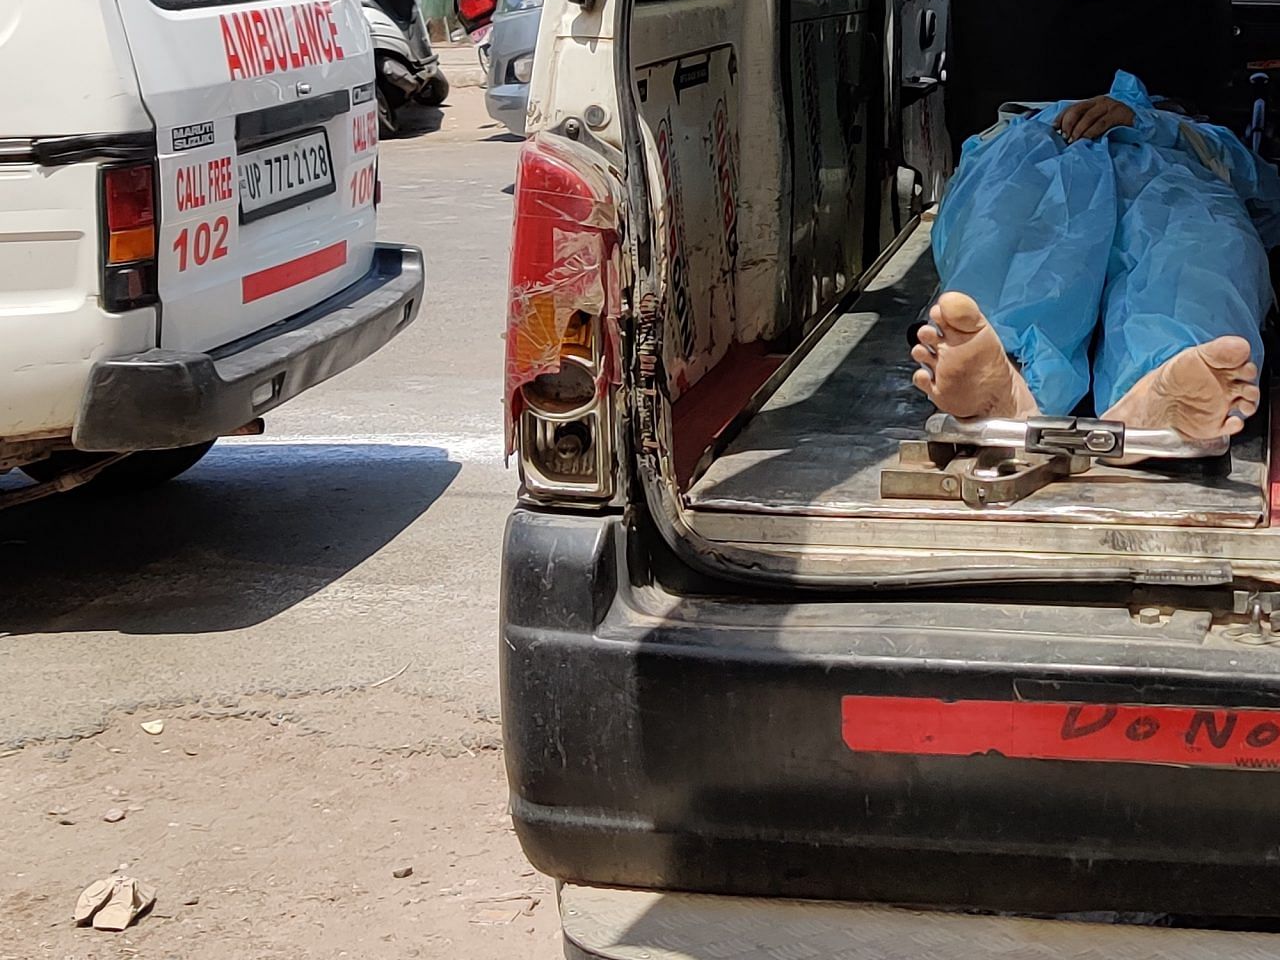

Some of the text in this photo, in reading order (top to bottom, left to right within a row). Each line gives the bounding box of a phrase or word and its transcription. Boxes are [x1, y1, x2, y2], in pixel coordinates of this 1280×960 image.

[219, 1, 343, 81] AMBULANCE
[173, 123, 213, 139] MARUTI
[174, 134, 214, 150] SUZUKI
[176, 163, 205, 212] CALL
[208, 156, 232, 204] FREE
[244, 162, 261, 200] UP
[172, 216, 229, 273] 102
[1060, 704, 1160, 742] Do
